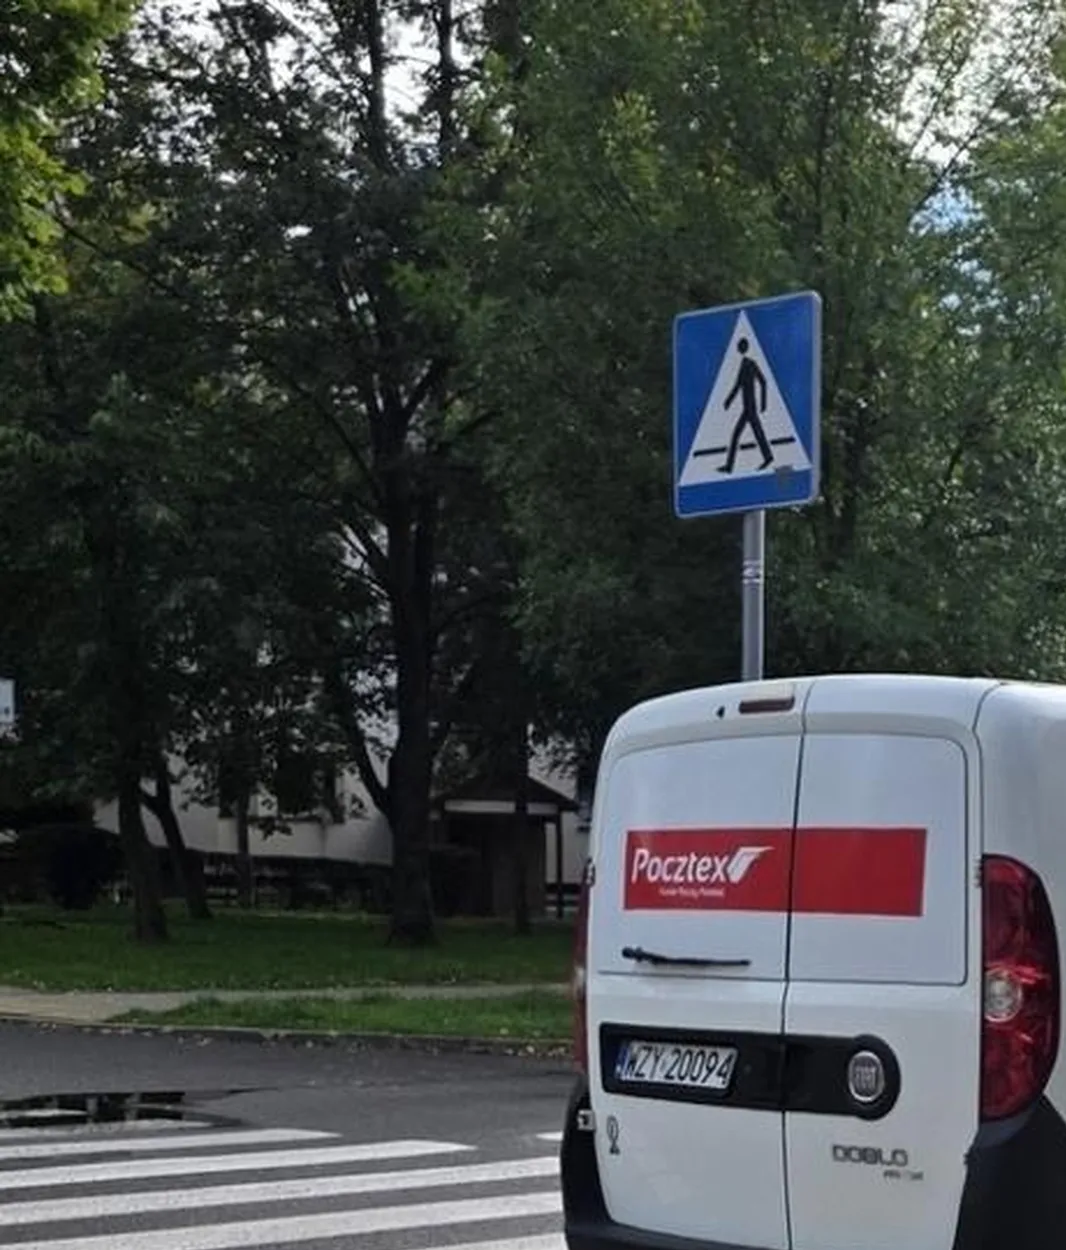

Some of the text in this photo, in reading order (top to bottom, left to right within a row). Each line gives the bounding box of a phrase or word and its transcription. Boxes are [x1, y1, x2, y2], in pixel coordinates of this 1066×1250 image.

[631, 847, 729, 884] Pocztex
[664, 1048, 734, 1086] 20094
[832, 1144, 909, 1168] DOBLO
